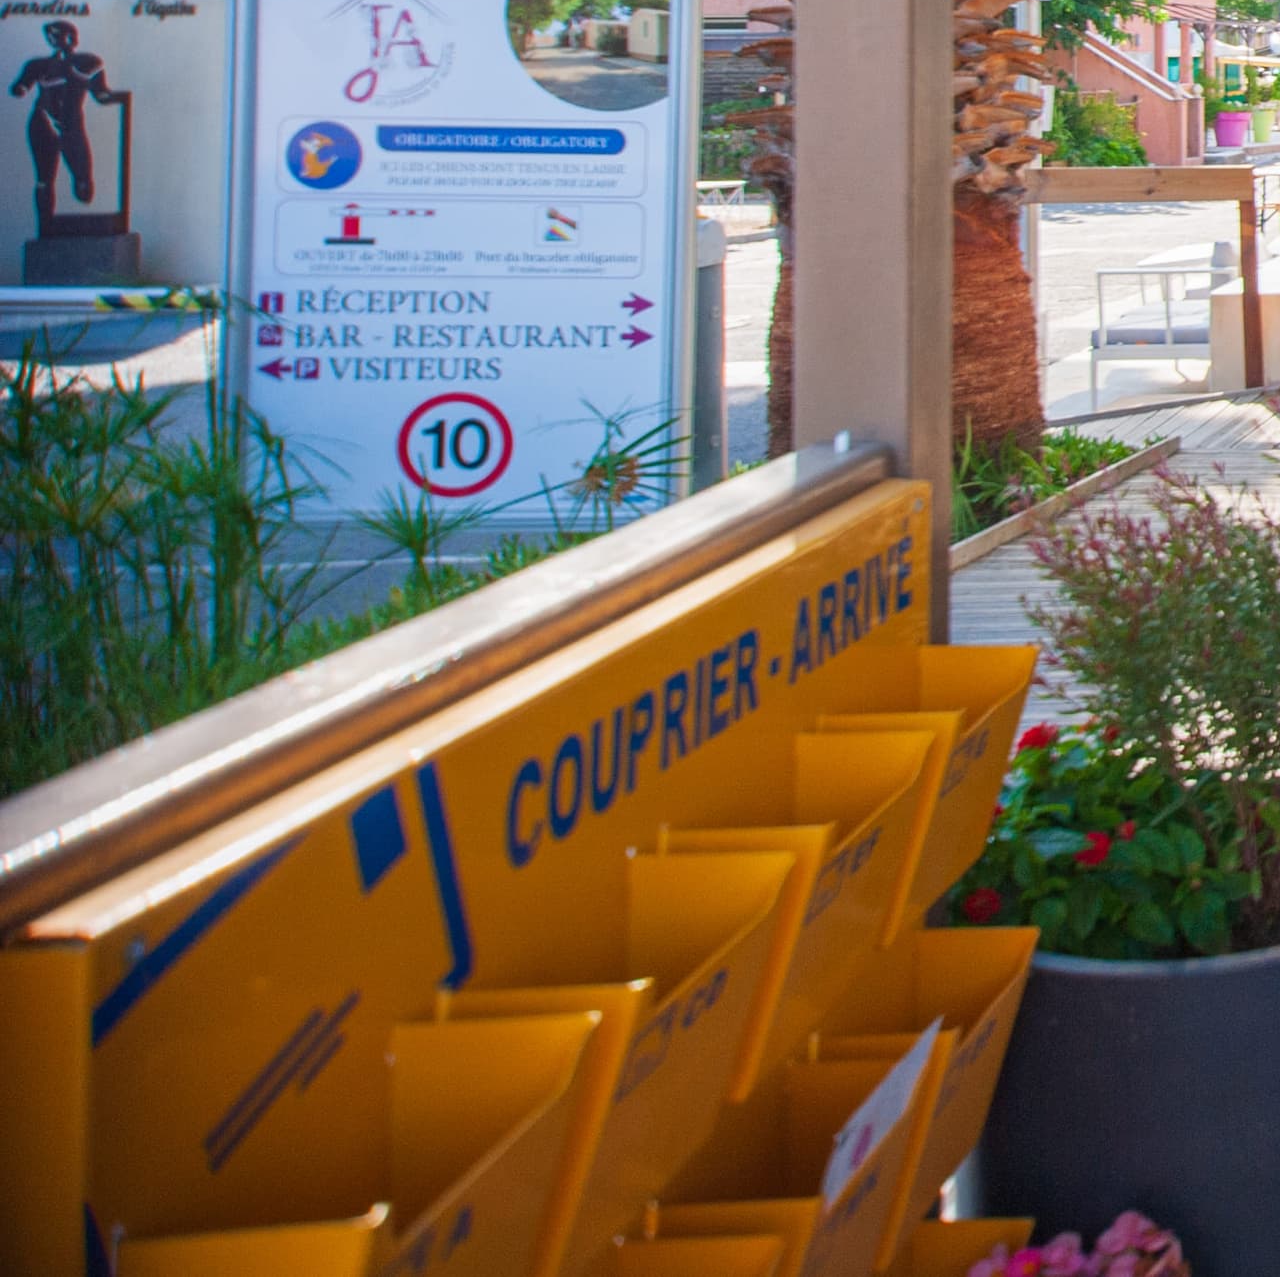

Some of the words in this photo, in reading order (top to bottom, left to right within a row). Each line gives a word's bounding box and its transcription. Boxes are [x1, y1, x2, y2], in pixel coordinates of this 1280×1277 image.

[295, 286, 491, 315] RÉCEPTION
[296, 325, 362, 348] BAR
[393, 325, 617, 349] RESTAURANT
[328, 357, 504, 382] VISITEURS
[421, 418, 491, 470] 10
